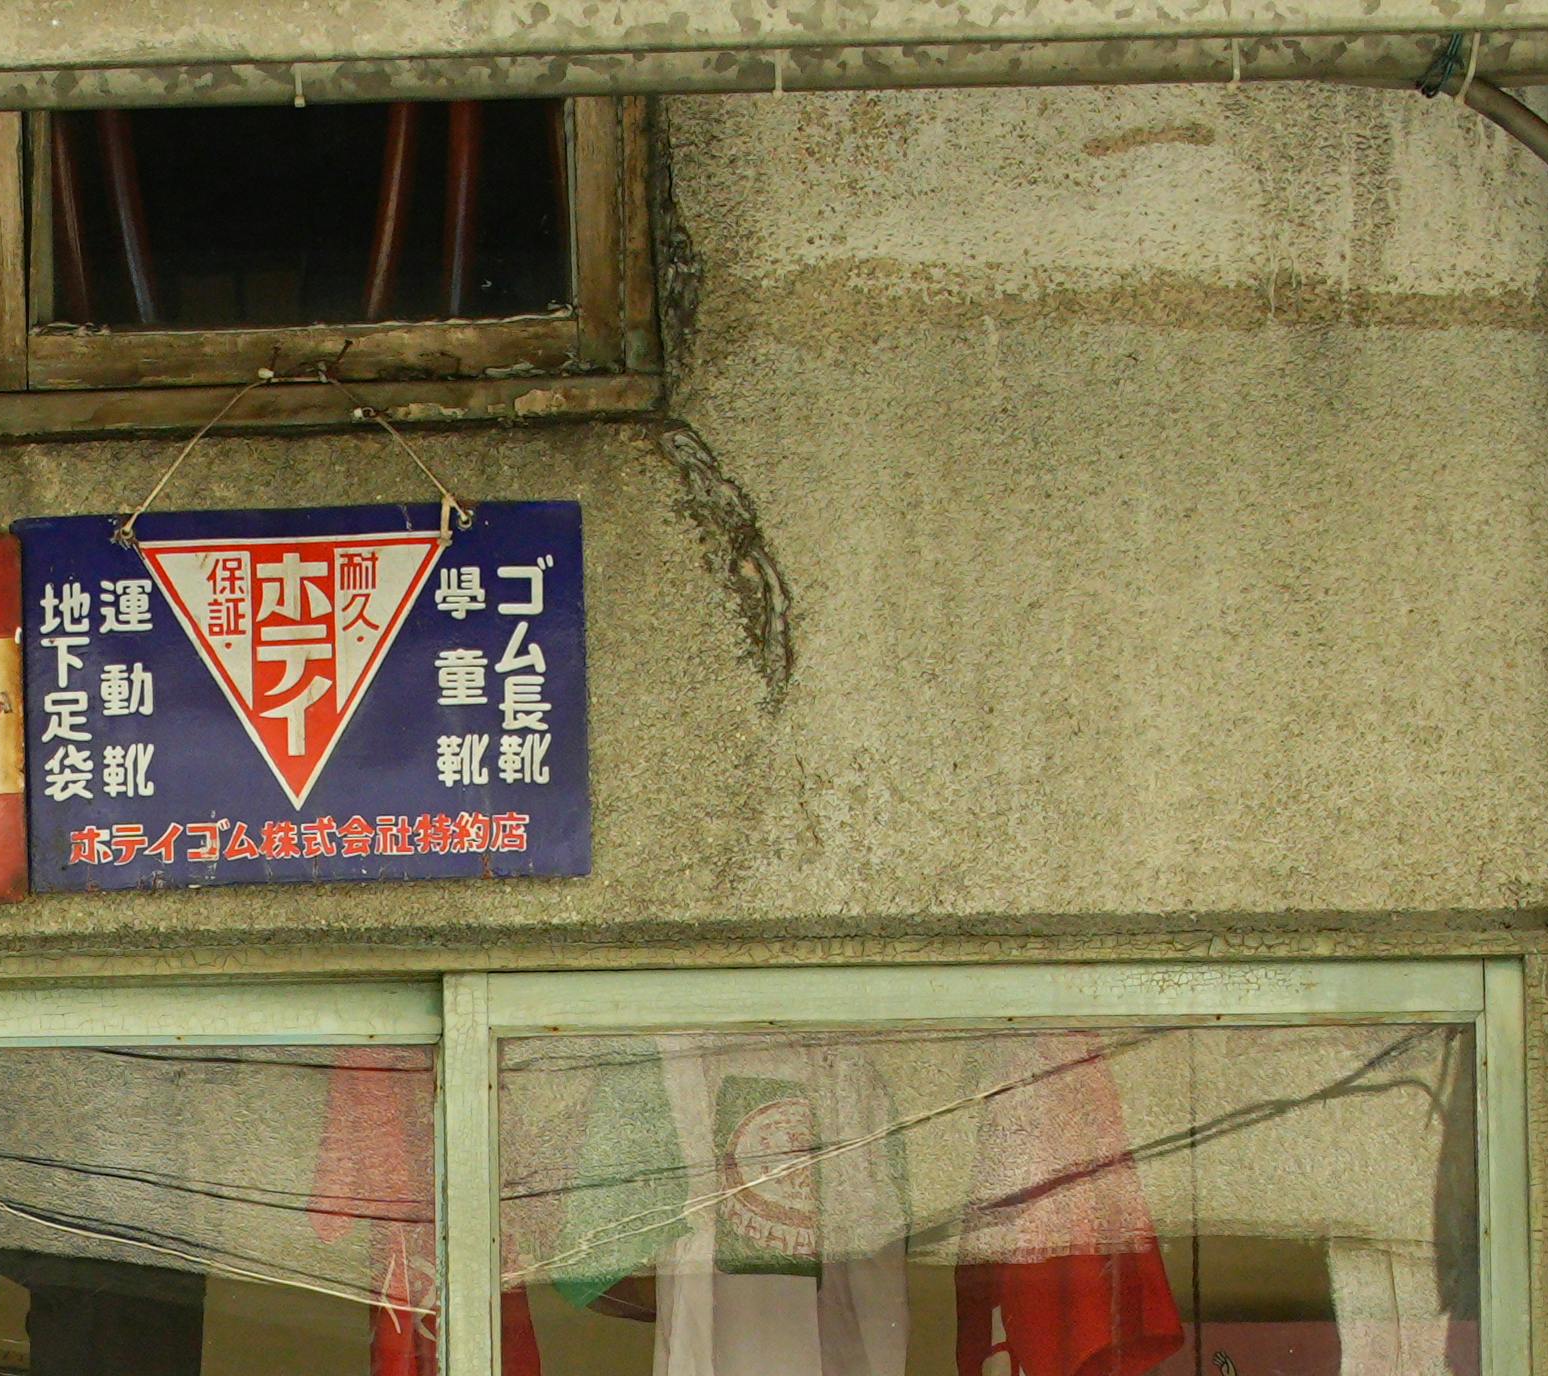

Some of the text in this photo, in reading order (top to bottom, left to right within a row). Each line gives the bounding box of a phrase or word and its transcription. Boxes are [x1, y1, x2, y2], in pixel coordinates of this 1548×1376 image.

[40, 581, 95, 803] 地下足袋
[99, 578, 156, 799] 運動靴
[206, 556, 248, 638] 保証
[255, 553, 333, 757] ホテイ
[336, 551, 381, 634] 耐久
[495, 554, 555, 785] ゴム長靴
[68, 811, 531, 868] ホテイゴム株式会社特約店
